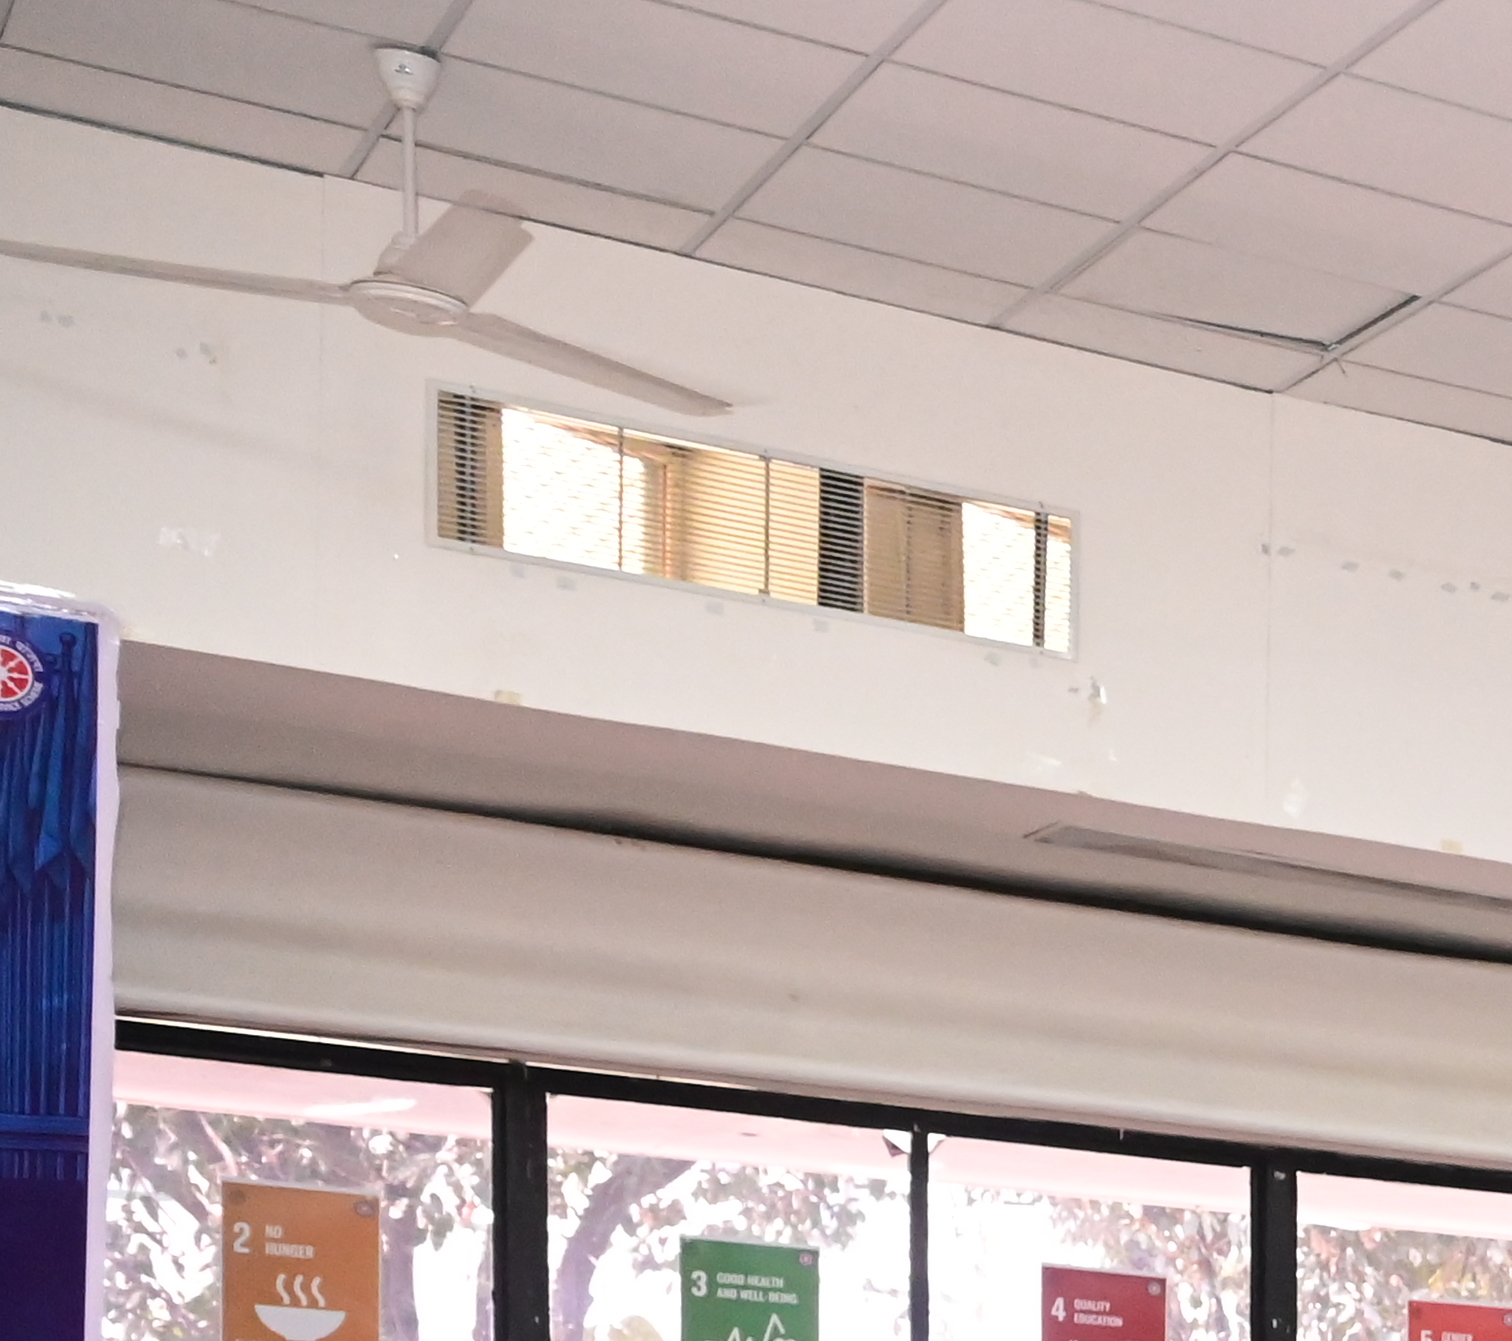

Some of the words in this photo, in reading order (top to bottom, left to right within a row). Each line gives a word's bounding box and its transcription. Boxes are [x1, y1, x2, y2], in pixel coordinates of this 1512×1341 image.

[233, 1221, 250, 1254] 2
[265, 1224, 283, 1239] NO
[265, 1242, 315, 1259] HUNGER
[691, 1270, 708, 1297] 3
[716, 1271, 745, 1286] GOOD
[747, 1274, 784, 1288] HEALTH
[716, 1287, 738, 1300] AND
[1051, 1296, 1067, 1322] 4
[1074, 1298, 1111, 1313] QUALITY
